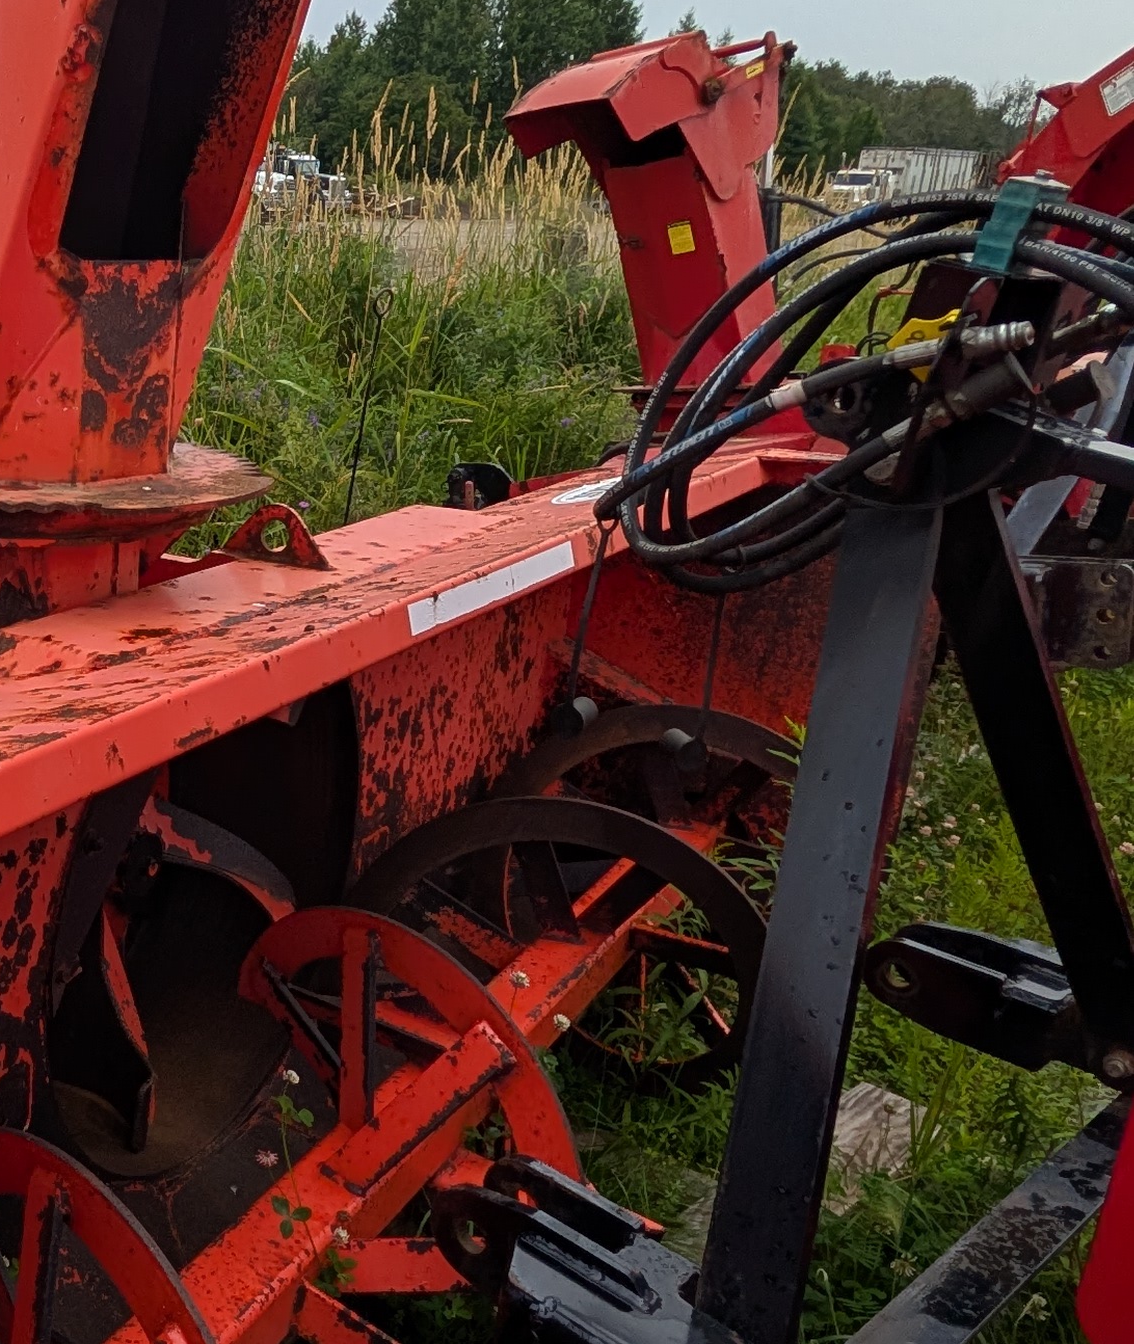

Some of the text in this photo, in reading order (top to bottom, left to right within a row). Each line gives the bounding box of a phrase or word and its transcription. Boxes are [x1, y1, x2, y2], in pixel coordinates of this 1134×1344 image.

[975, 193, 999, 203] SAE
[1052, 205, 1085, 222] DN10
[1086, 212, 1111, 228] 3/8"
[1111, 222, 1132, 238] WP
[1078, 259, 1099, 273] PSI
